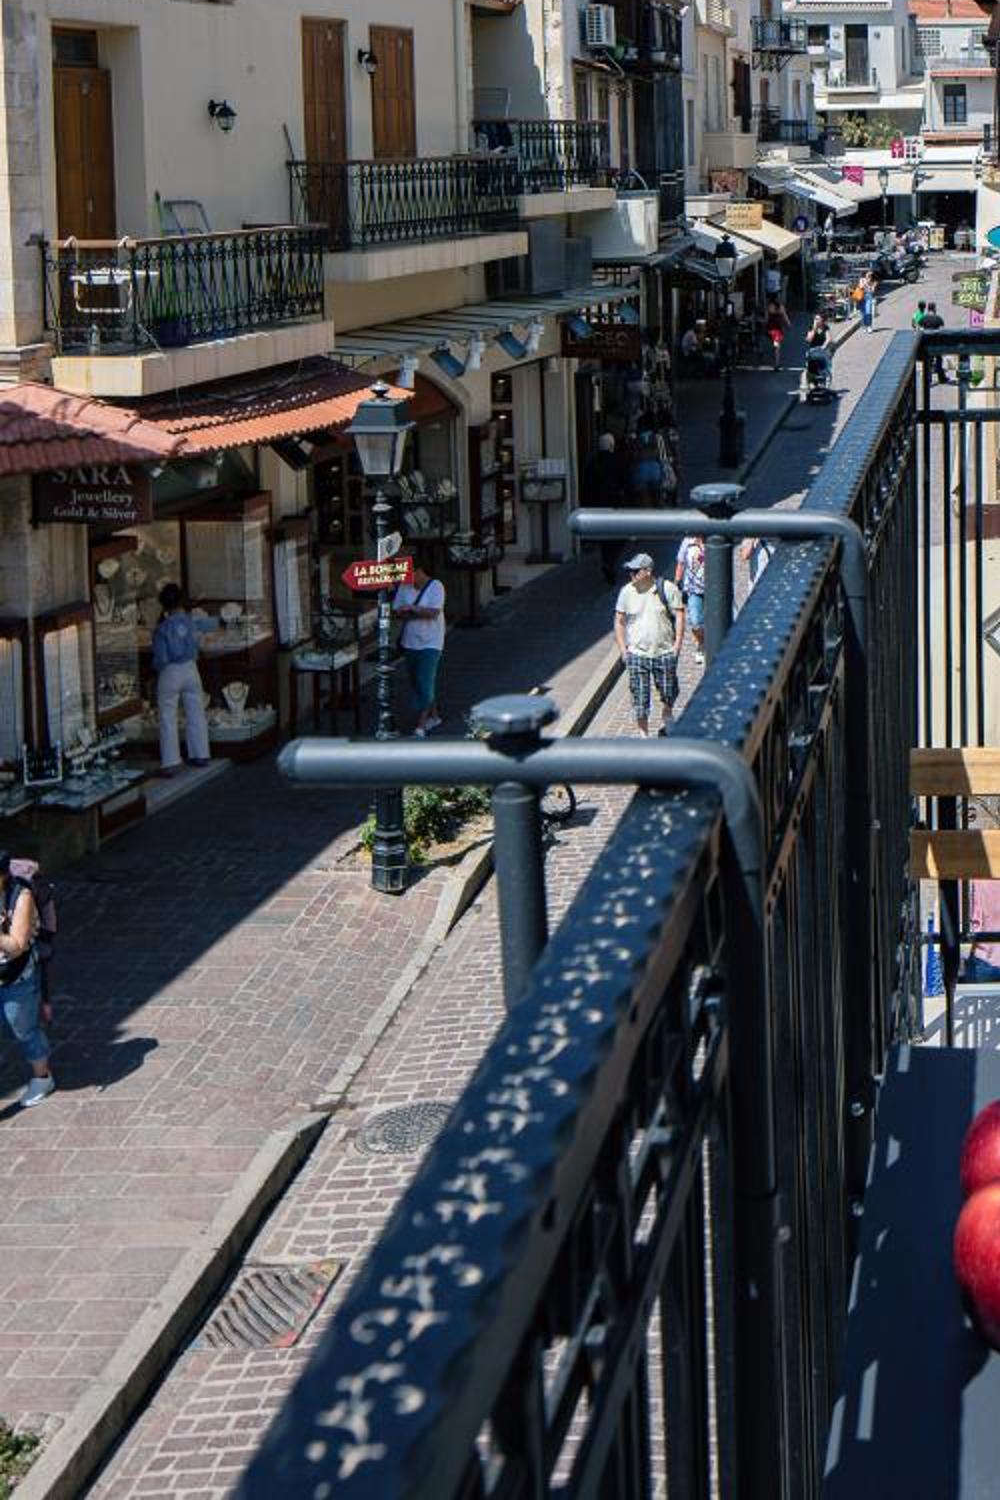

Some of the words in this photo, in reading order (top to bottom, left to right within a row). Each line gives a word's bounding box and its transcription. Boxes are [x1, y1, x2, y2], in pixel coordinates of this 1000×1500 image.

[69, 488, 133, 507] Jewellery
[53, 504, 84, 517] Gold
[102, 506, 137, 518] Silver
[353, 566, 367, 577] LA
